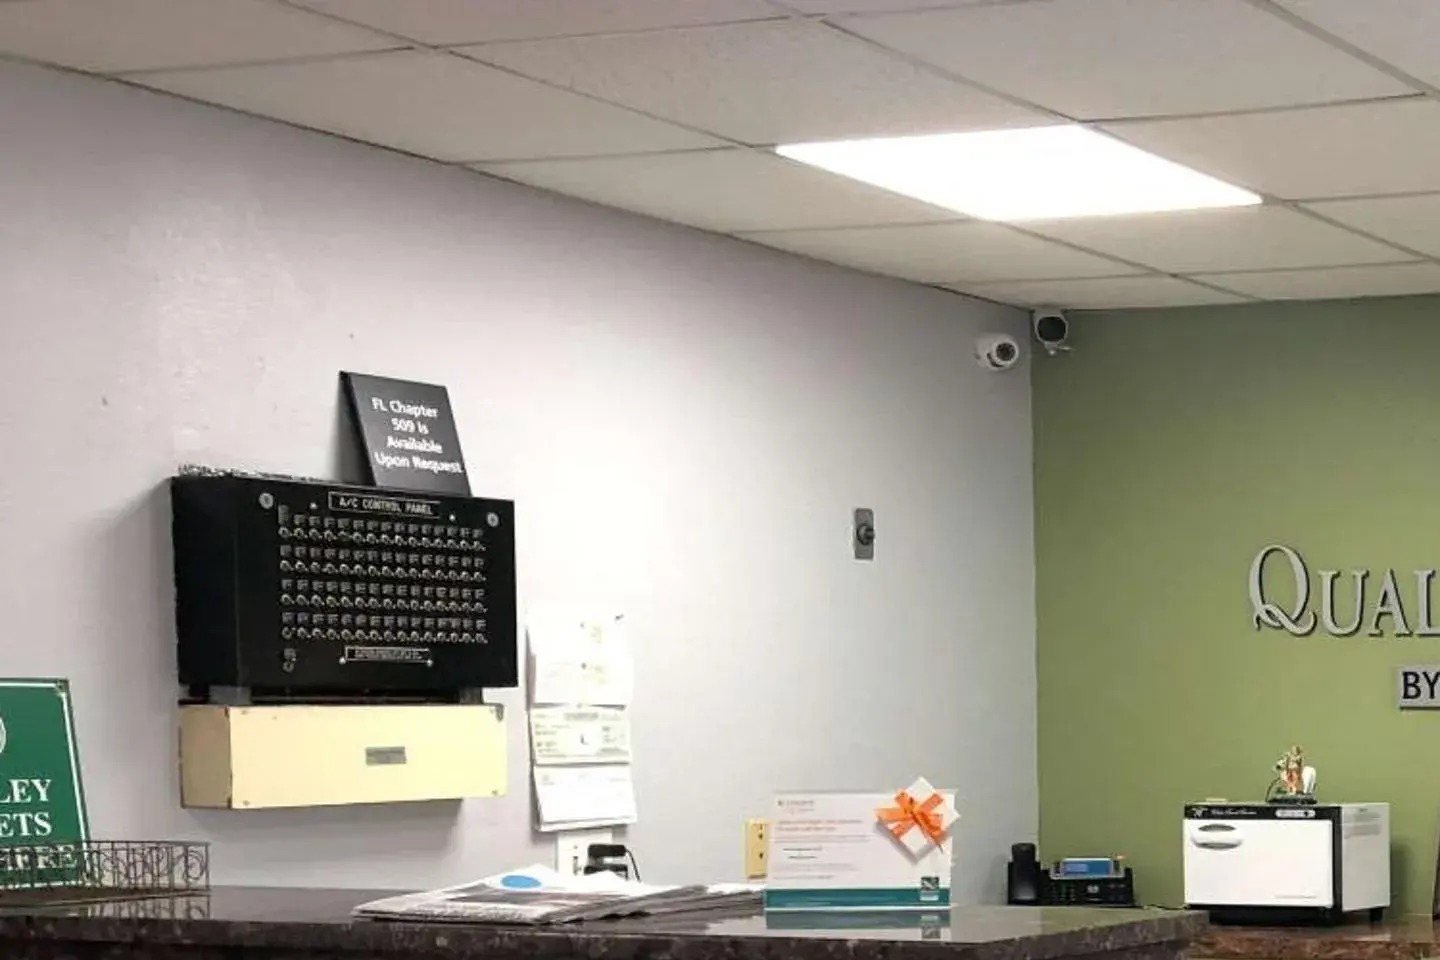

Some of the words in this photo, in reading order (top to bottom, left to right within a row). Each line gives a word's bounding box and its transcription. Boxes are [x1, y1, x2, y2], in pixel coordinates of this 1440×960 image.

[389, 400, 439, 418] Chapter
[386, 436, 443, 453] Available
[374, 452, 410, 469] Upon
[1402, 671, 1440, 701] BY
